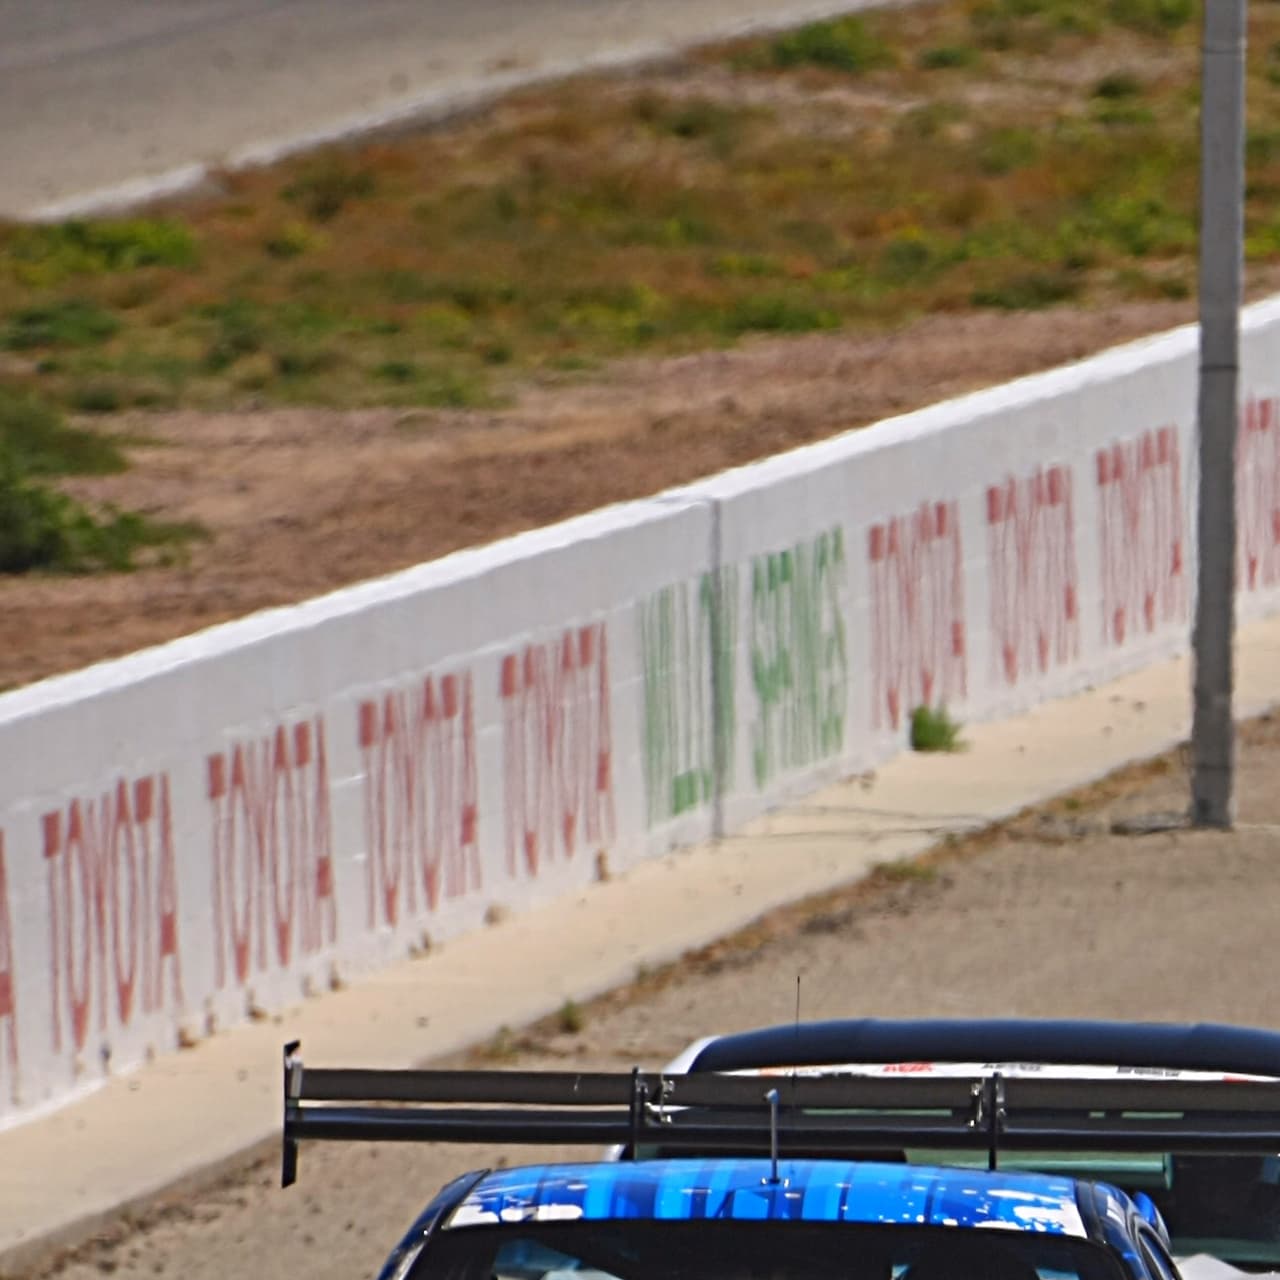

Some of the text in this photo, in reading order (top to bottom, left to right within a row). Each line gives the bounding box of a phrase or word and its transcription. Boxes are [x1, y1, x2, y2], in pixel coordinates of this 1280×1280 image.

[43, 771, 184, 1053] TOYOTA
[208, 713, 339, 989] TOYOTA
[359, 669, 483, 929] TOYOTA
[499, 621, 616, 880] TOYOTA
